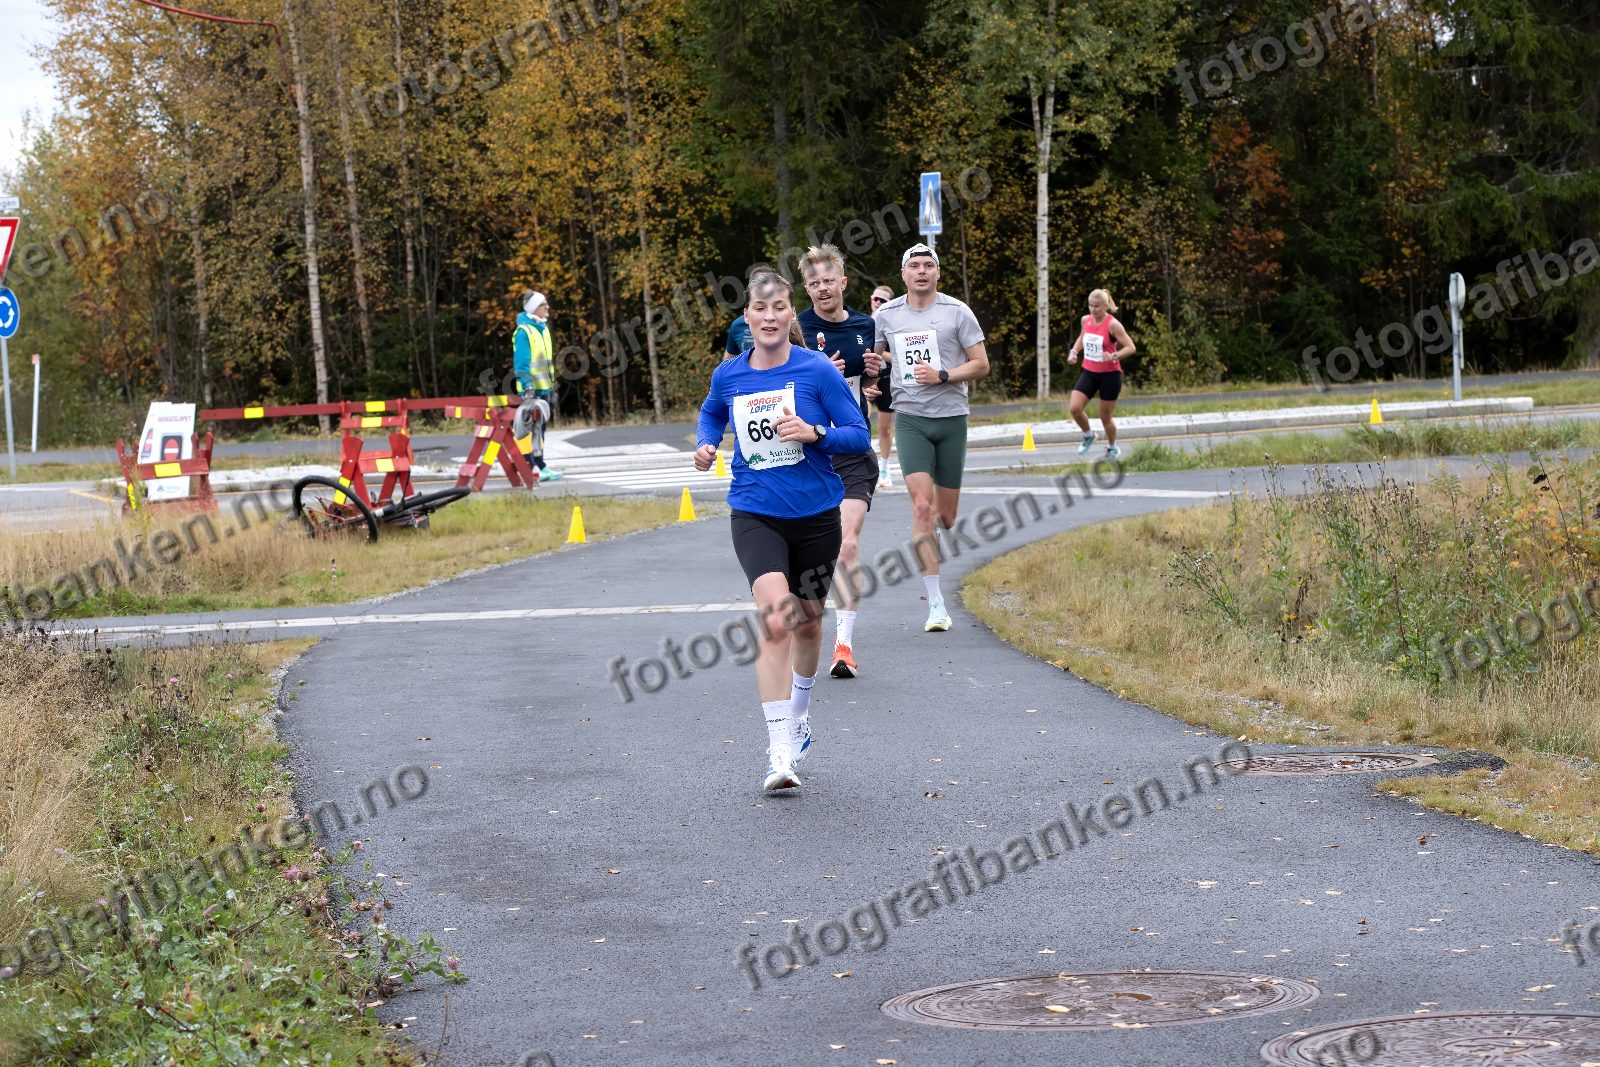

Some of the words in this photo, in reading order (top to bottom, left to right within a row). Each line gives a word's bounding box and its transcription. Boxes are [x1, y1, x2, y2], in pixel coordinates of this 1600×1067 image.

[905, 348, 931, 366] 534
[746, 395, 783, 408] NORGES
[749, 403, 777, 414] LØPET
[747, 417, 777, 443] 66
